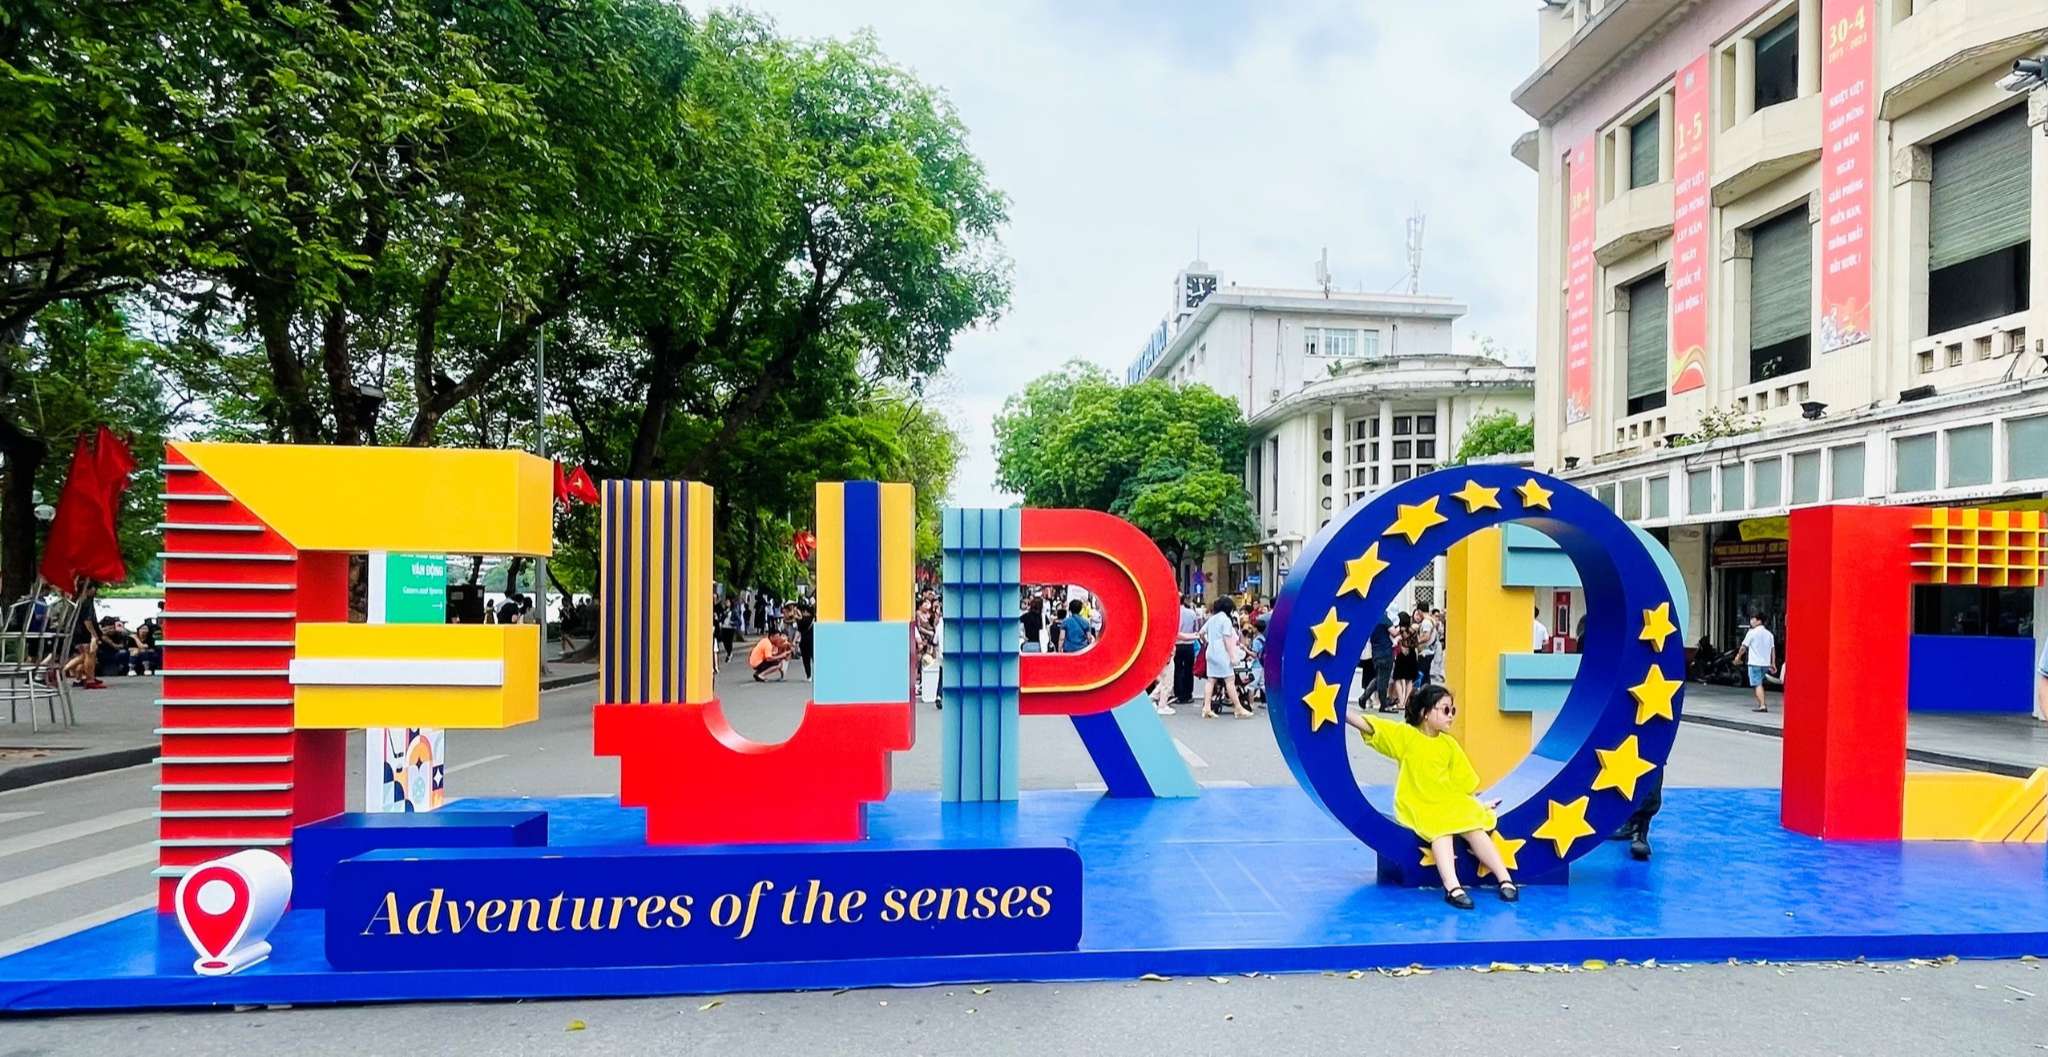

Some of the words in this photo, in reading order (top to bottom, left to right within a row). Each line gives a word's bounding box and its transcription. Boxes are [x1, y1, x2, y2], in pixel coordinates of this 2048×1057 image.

[1829, 5, 1865, 49] 30-4
[1679, 112, 1702, 150] 1-5
[360, 888, 694, 936] Adventures
[710, 880, 775, 940] of
[781, 880, 867, 926] the
[880, 885, 1054, 923] senses
